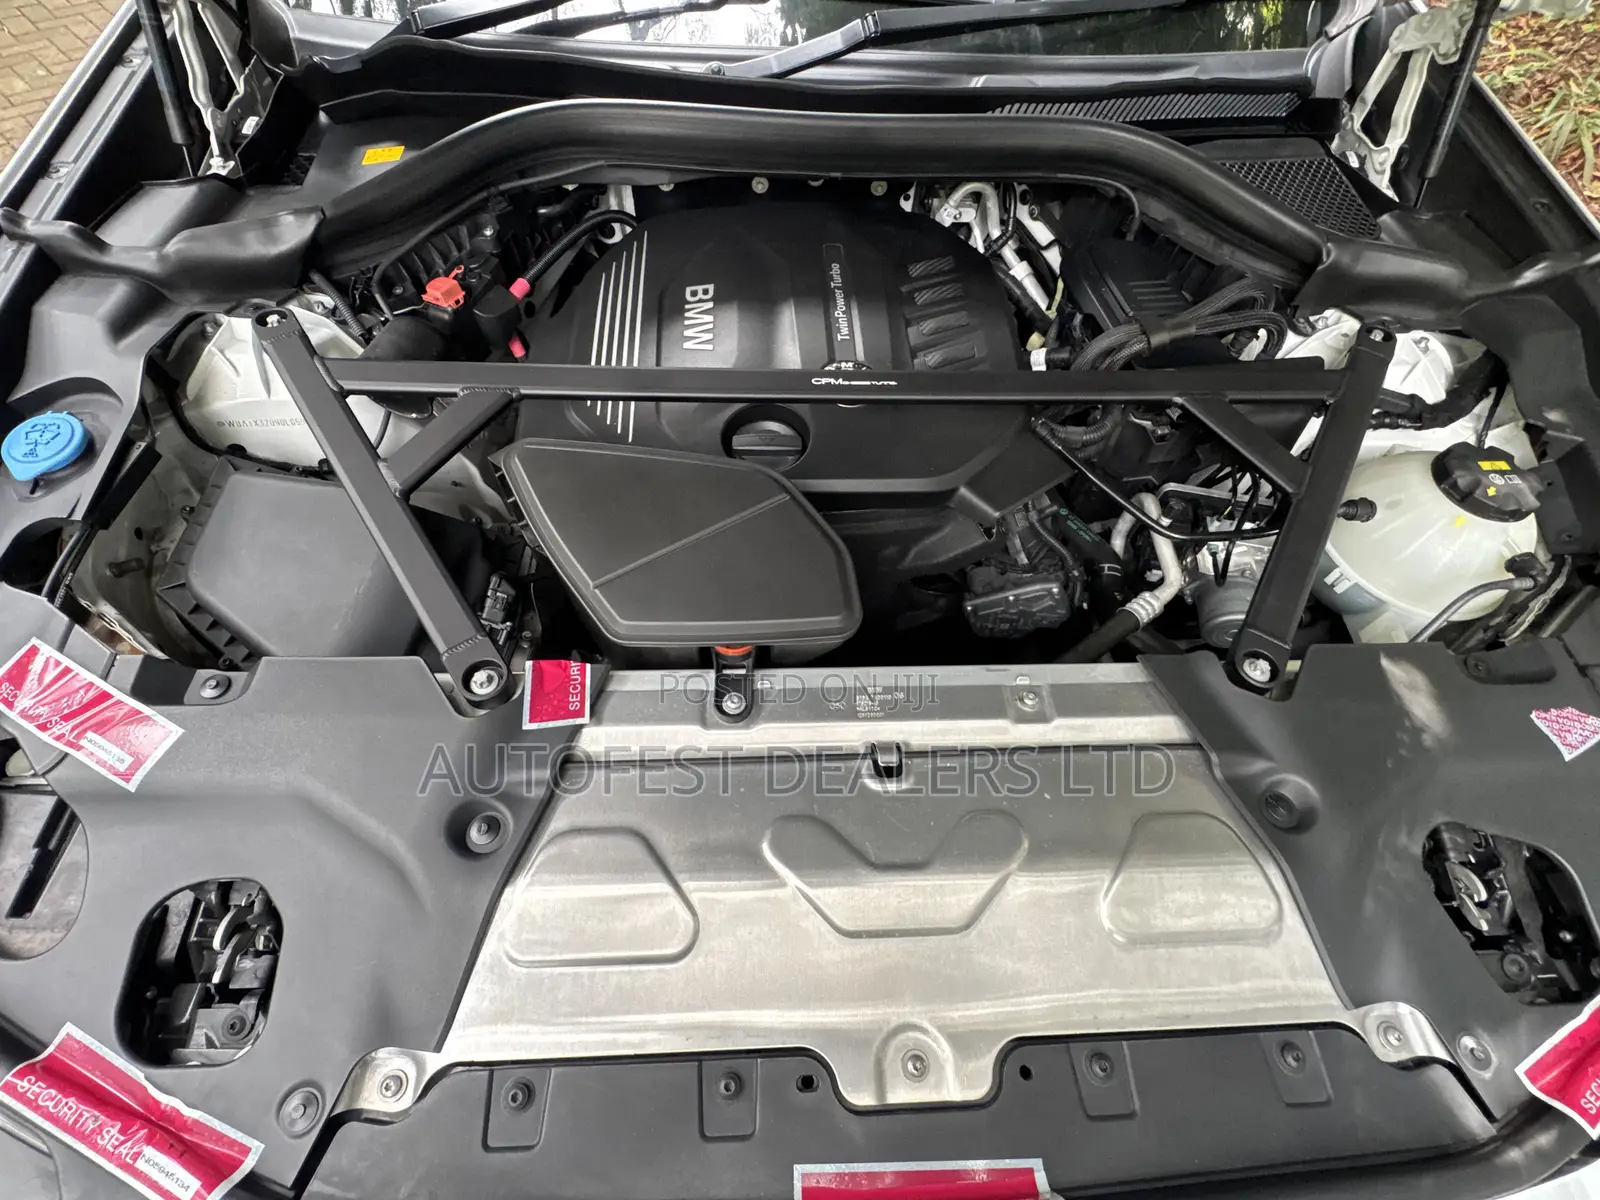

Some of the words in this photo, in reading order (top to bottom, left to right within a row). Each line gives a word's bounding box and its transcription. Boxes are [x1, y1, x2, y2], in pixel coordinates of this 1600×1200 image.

[829, 262, 843, 288] Turbo
[683, 284, 714, 350] BMW
[834, 288, 850, 341] TwinPower
[16, 1075, 99, 1134] SECURITY
[96, 1125, 139, 1166] SEAL
